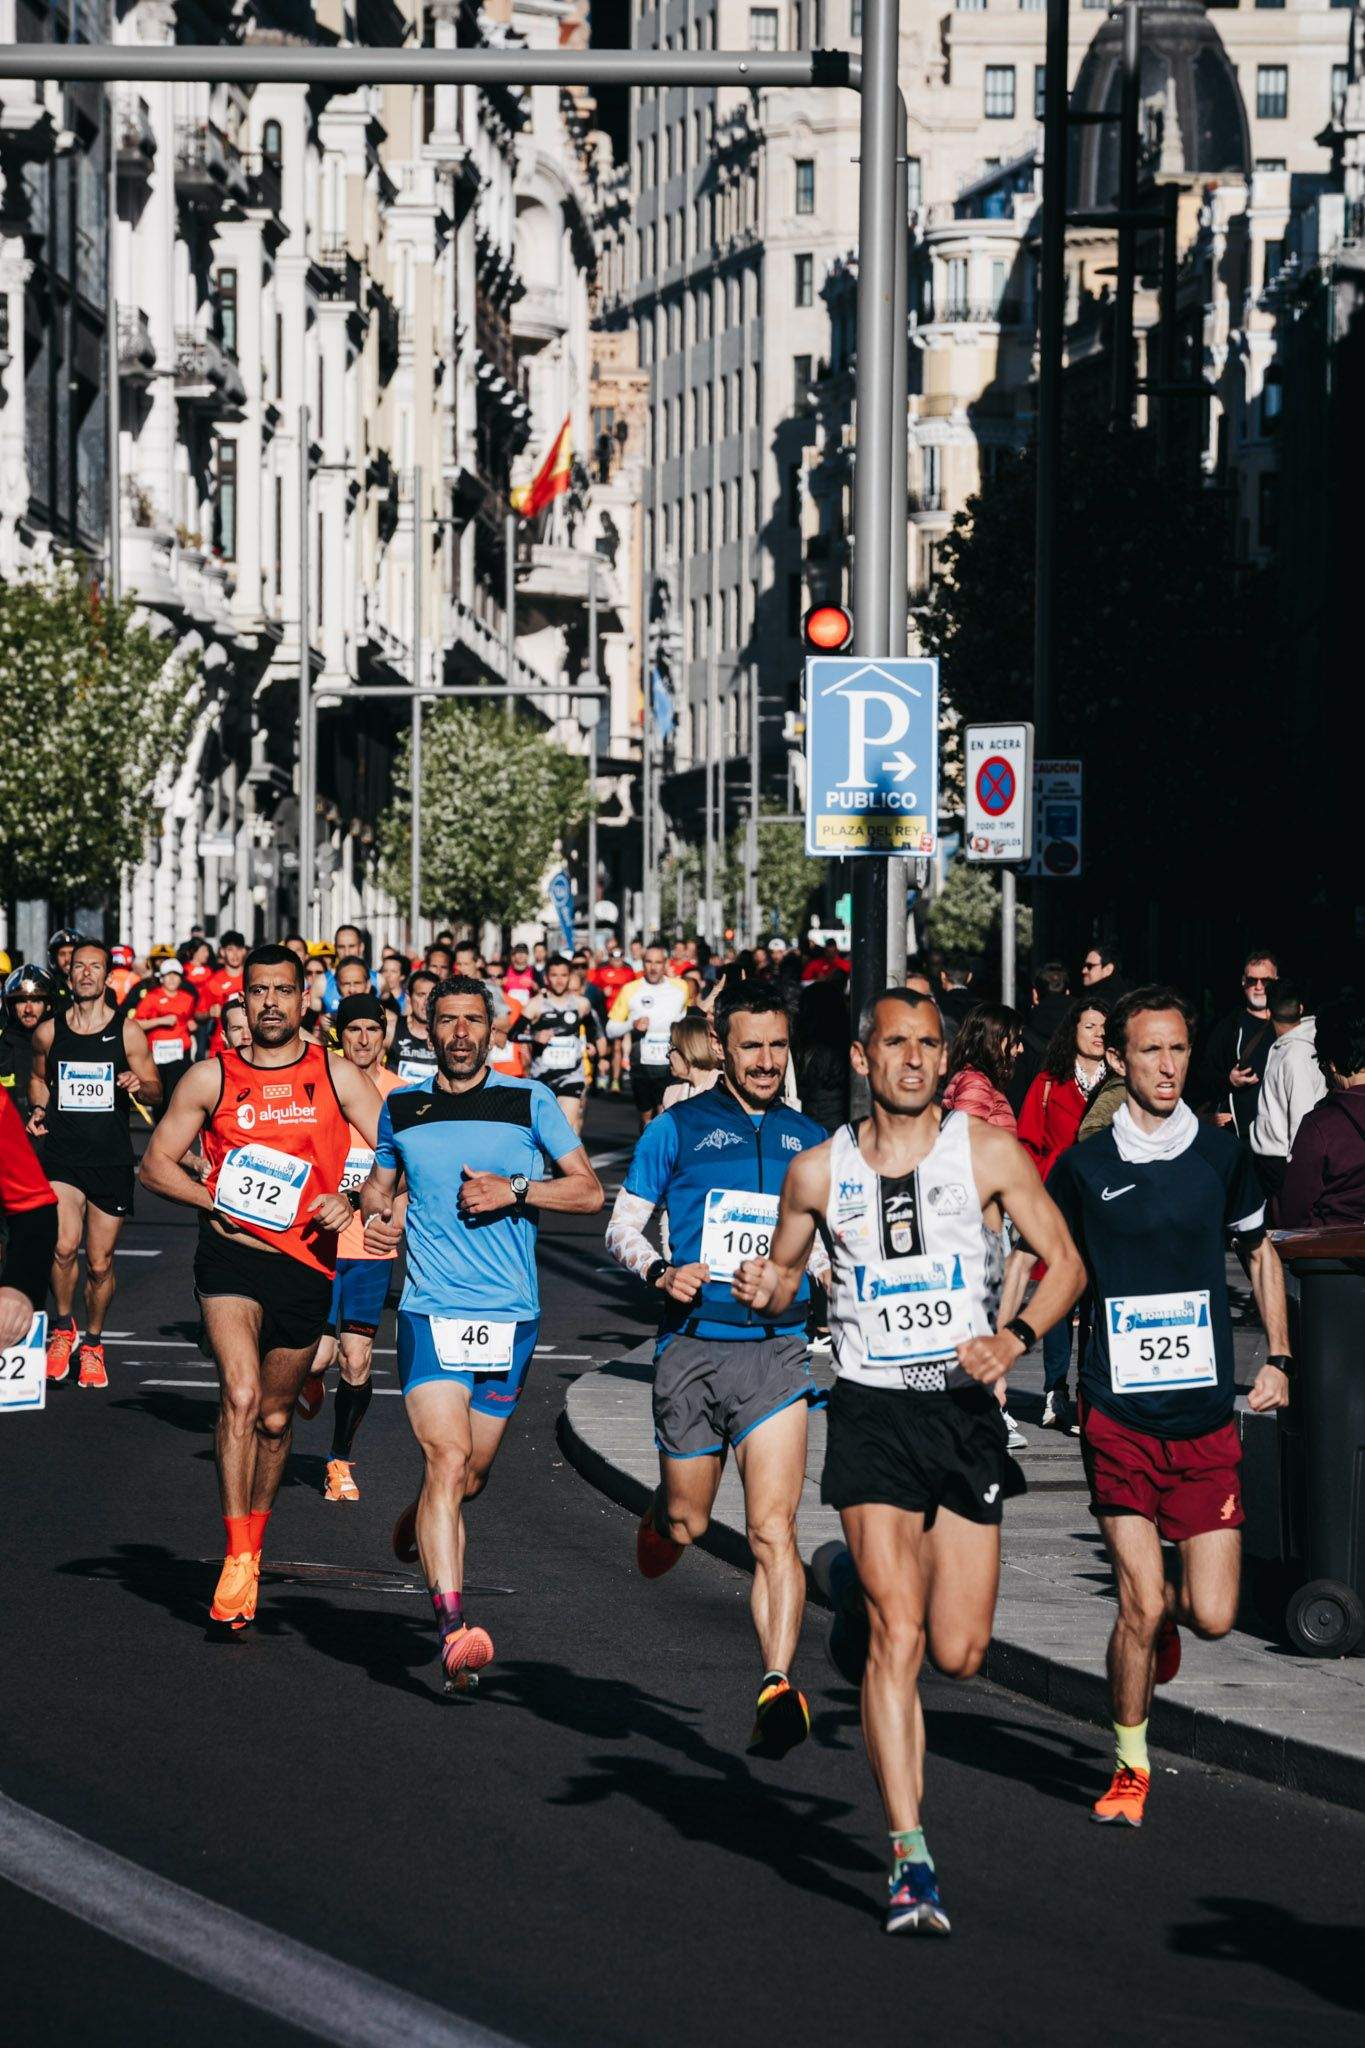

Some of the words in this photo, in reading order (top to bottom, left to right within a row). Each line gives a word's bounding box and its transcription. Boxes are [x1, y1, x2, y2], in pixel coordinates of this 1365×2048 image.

[836, 690, 910, 788] P
[971, 740, 984, 751] EN
[990, 739, 1021, 750] ACERA
[826, 791, 918, 809] PUBLICO
[823, 825, 864, 836] PLAZA
[868, 825, 890, 836] DEL
[895, 825, 920, 836] REY
[976, 821, 995, 831] TODO
[1000, 821, 1015, 830] TIPO
[69, 1083, 104, 1097] 1290
[259, 1100, 317, 1121] alquiber
[238, 1176, 282, 1205] 312
[878, 1300, 952, 1332] 1339
[461, 1325, 489, 1345] 46
[1139, 1335, 1190, 1361] 525
